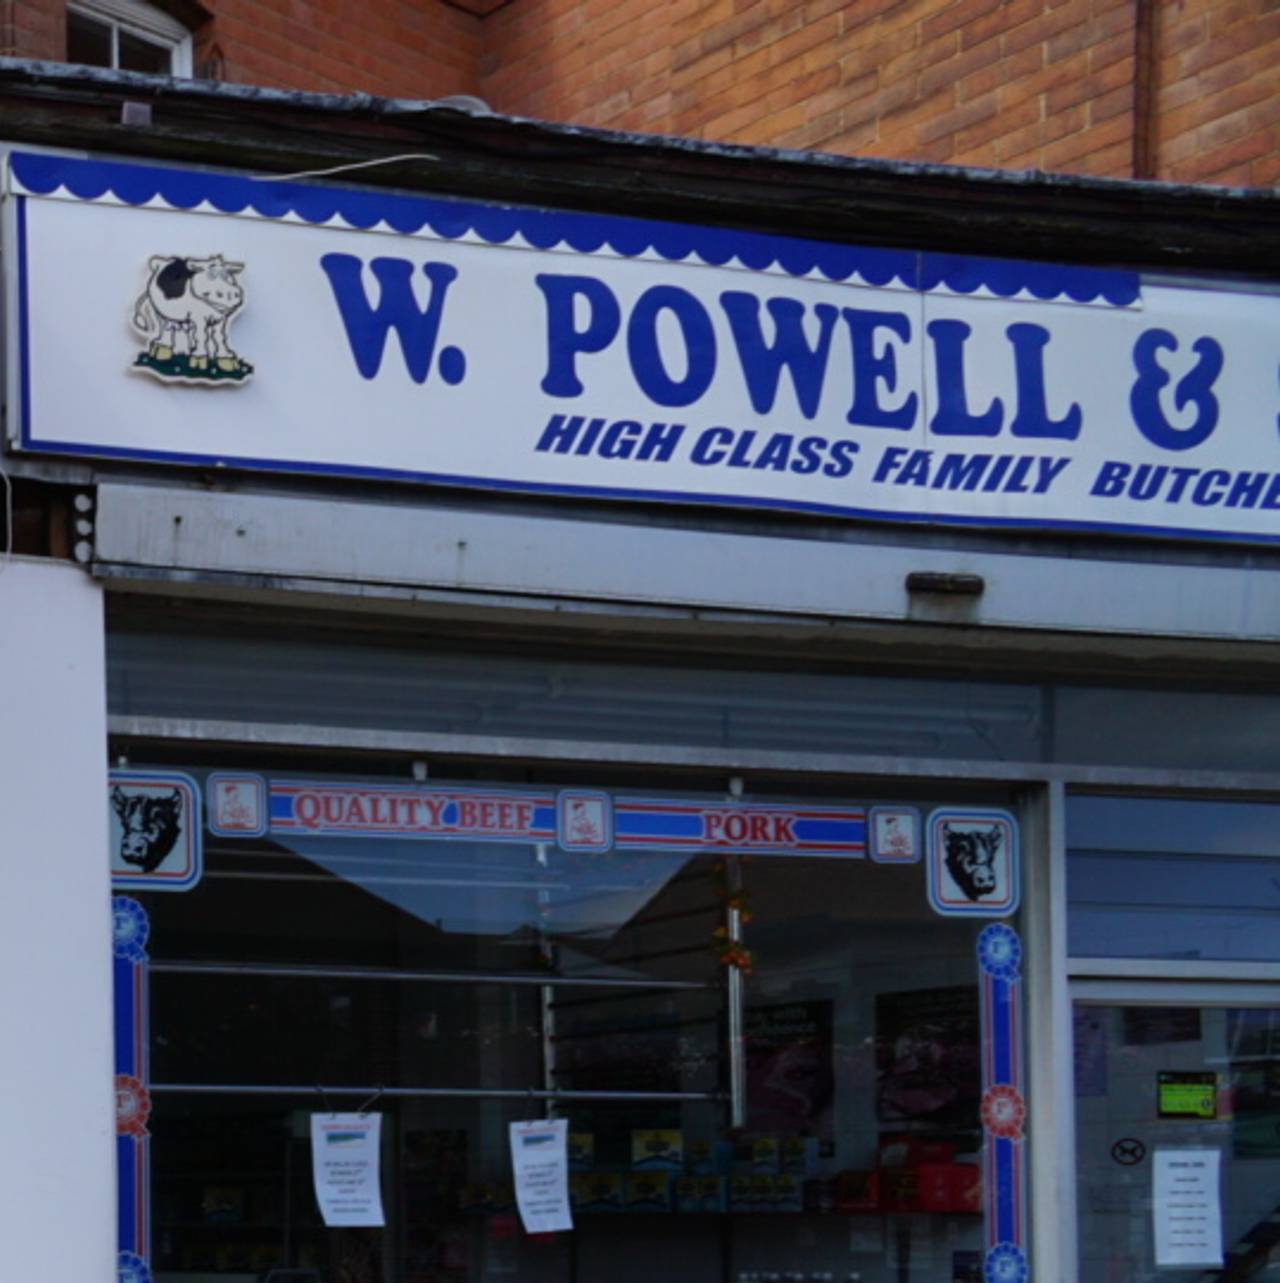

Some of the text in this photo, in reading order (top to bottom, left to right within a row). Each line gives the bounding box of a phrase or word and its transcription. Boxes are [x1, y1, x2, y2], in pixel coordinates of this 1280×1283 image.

[318, 252, 1224, 451] W. POWELL &
[534, 414, 682, 461] HIGH
[687, 424, 860, 480] CLASS
[872, 449, 1073, 495] FAMILY
[293, 794, 534, 833] QUALITY BEEF
[701, 811, 797, 844] PORK
